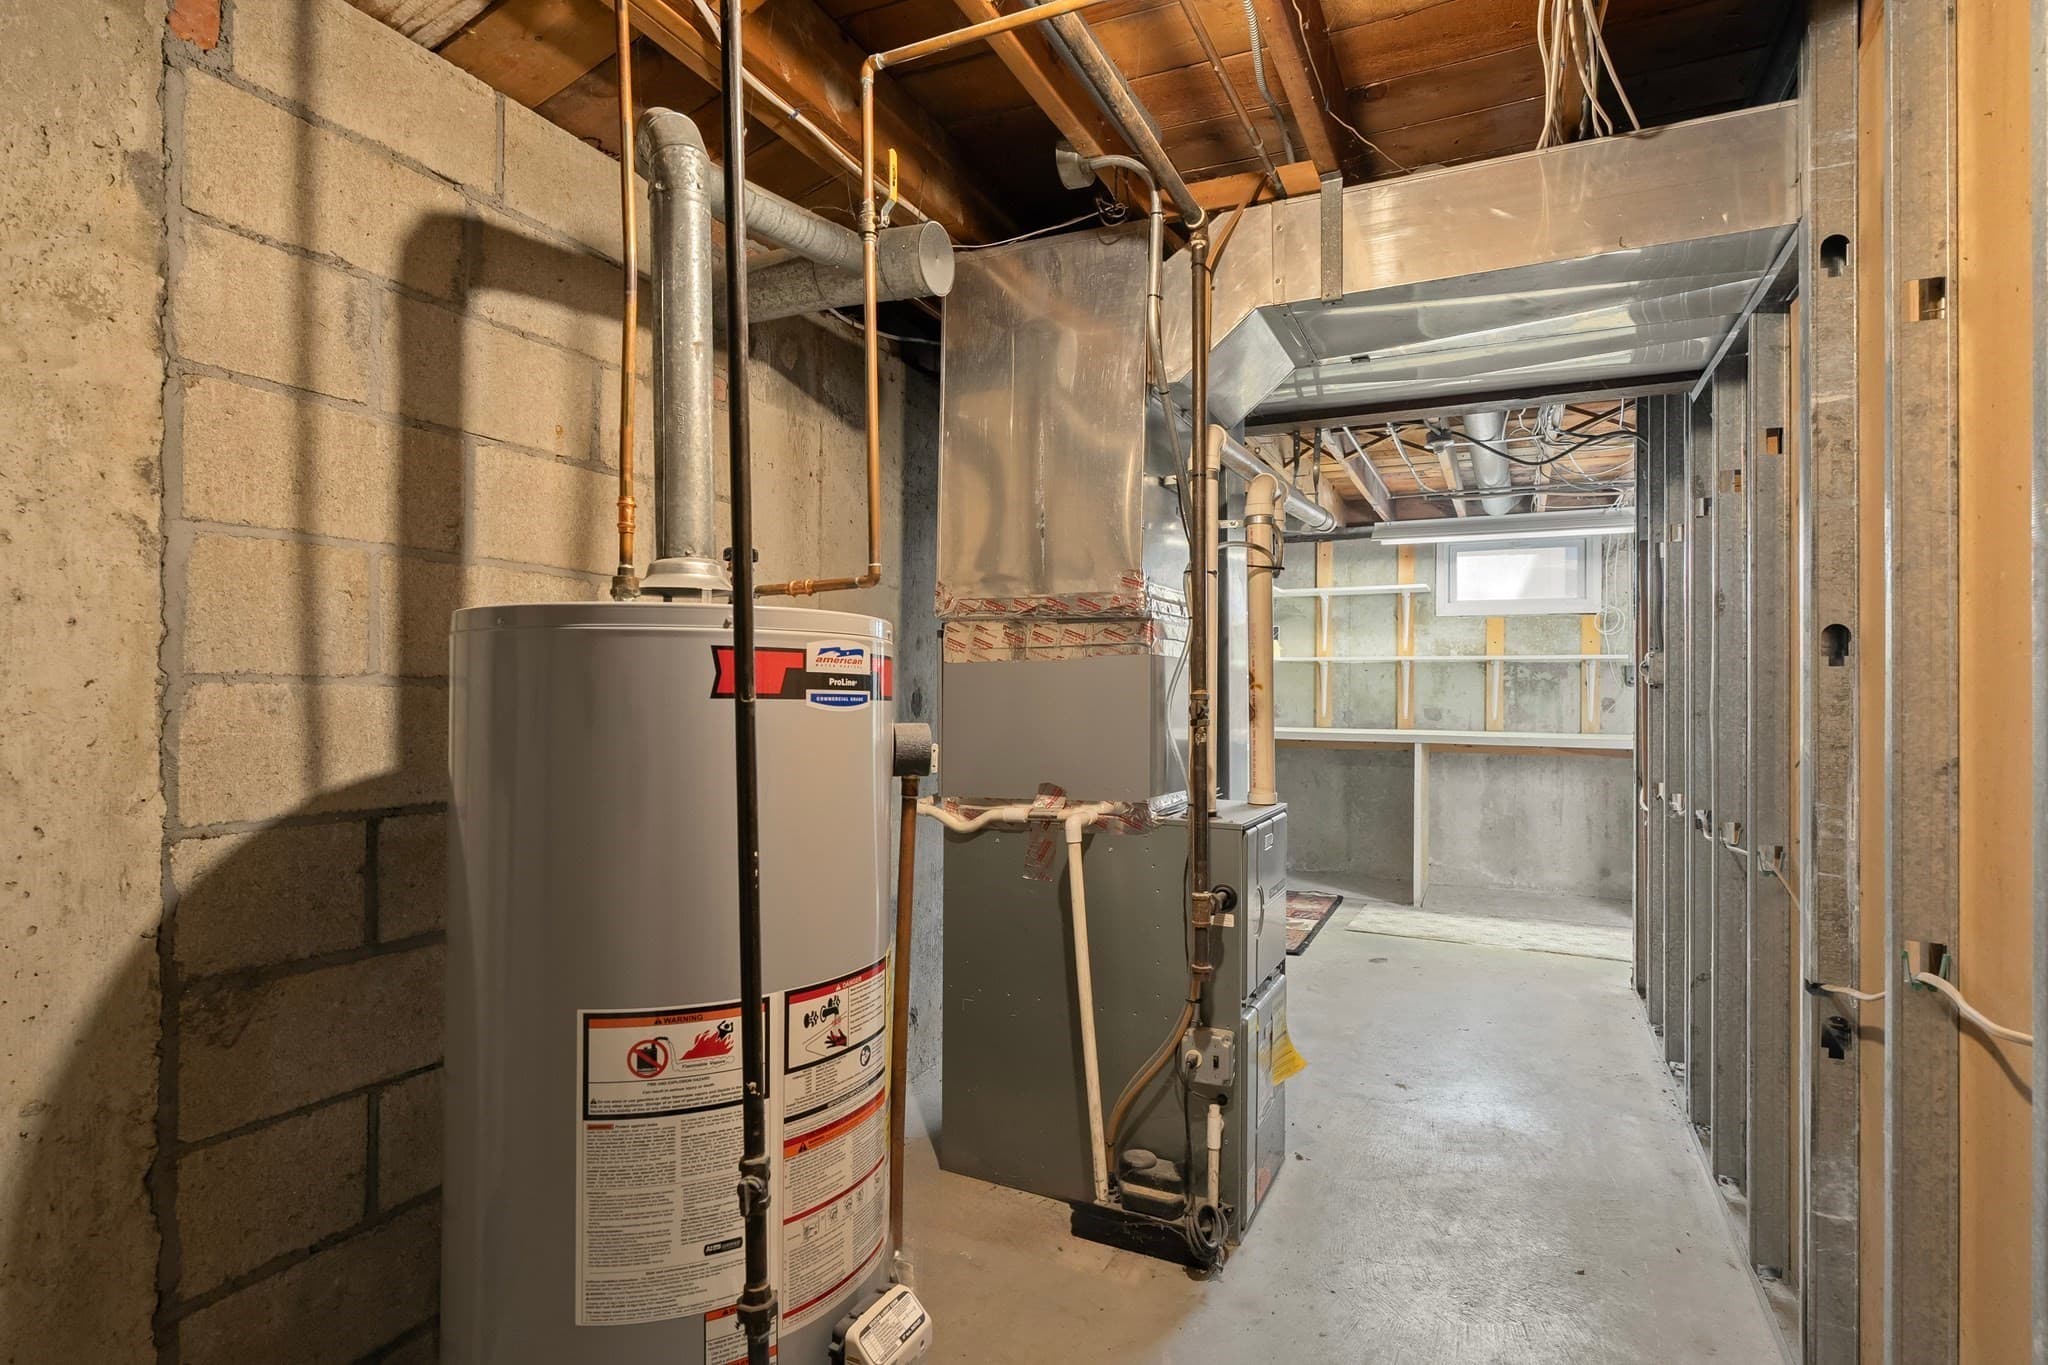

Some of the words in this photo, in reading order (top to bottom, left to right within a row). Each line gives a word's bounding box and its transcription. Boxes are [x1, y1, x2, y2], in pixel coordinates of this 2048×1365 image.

[815, 657, 863, 665] american
[829, 678, 856, 686] ProLine
[663, 1014, 704, 1025] WARNING
